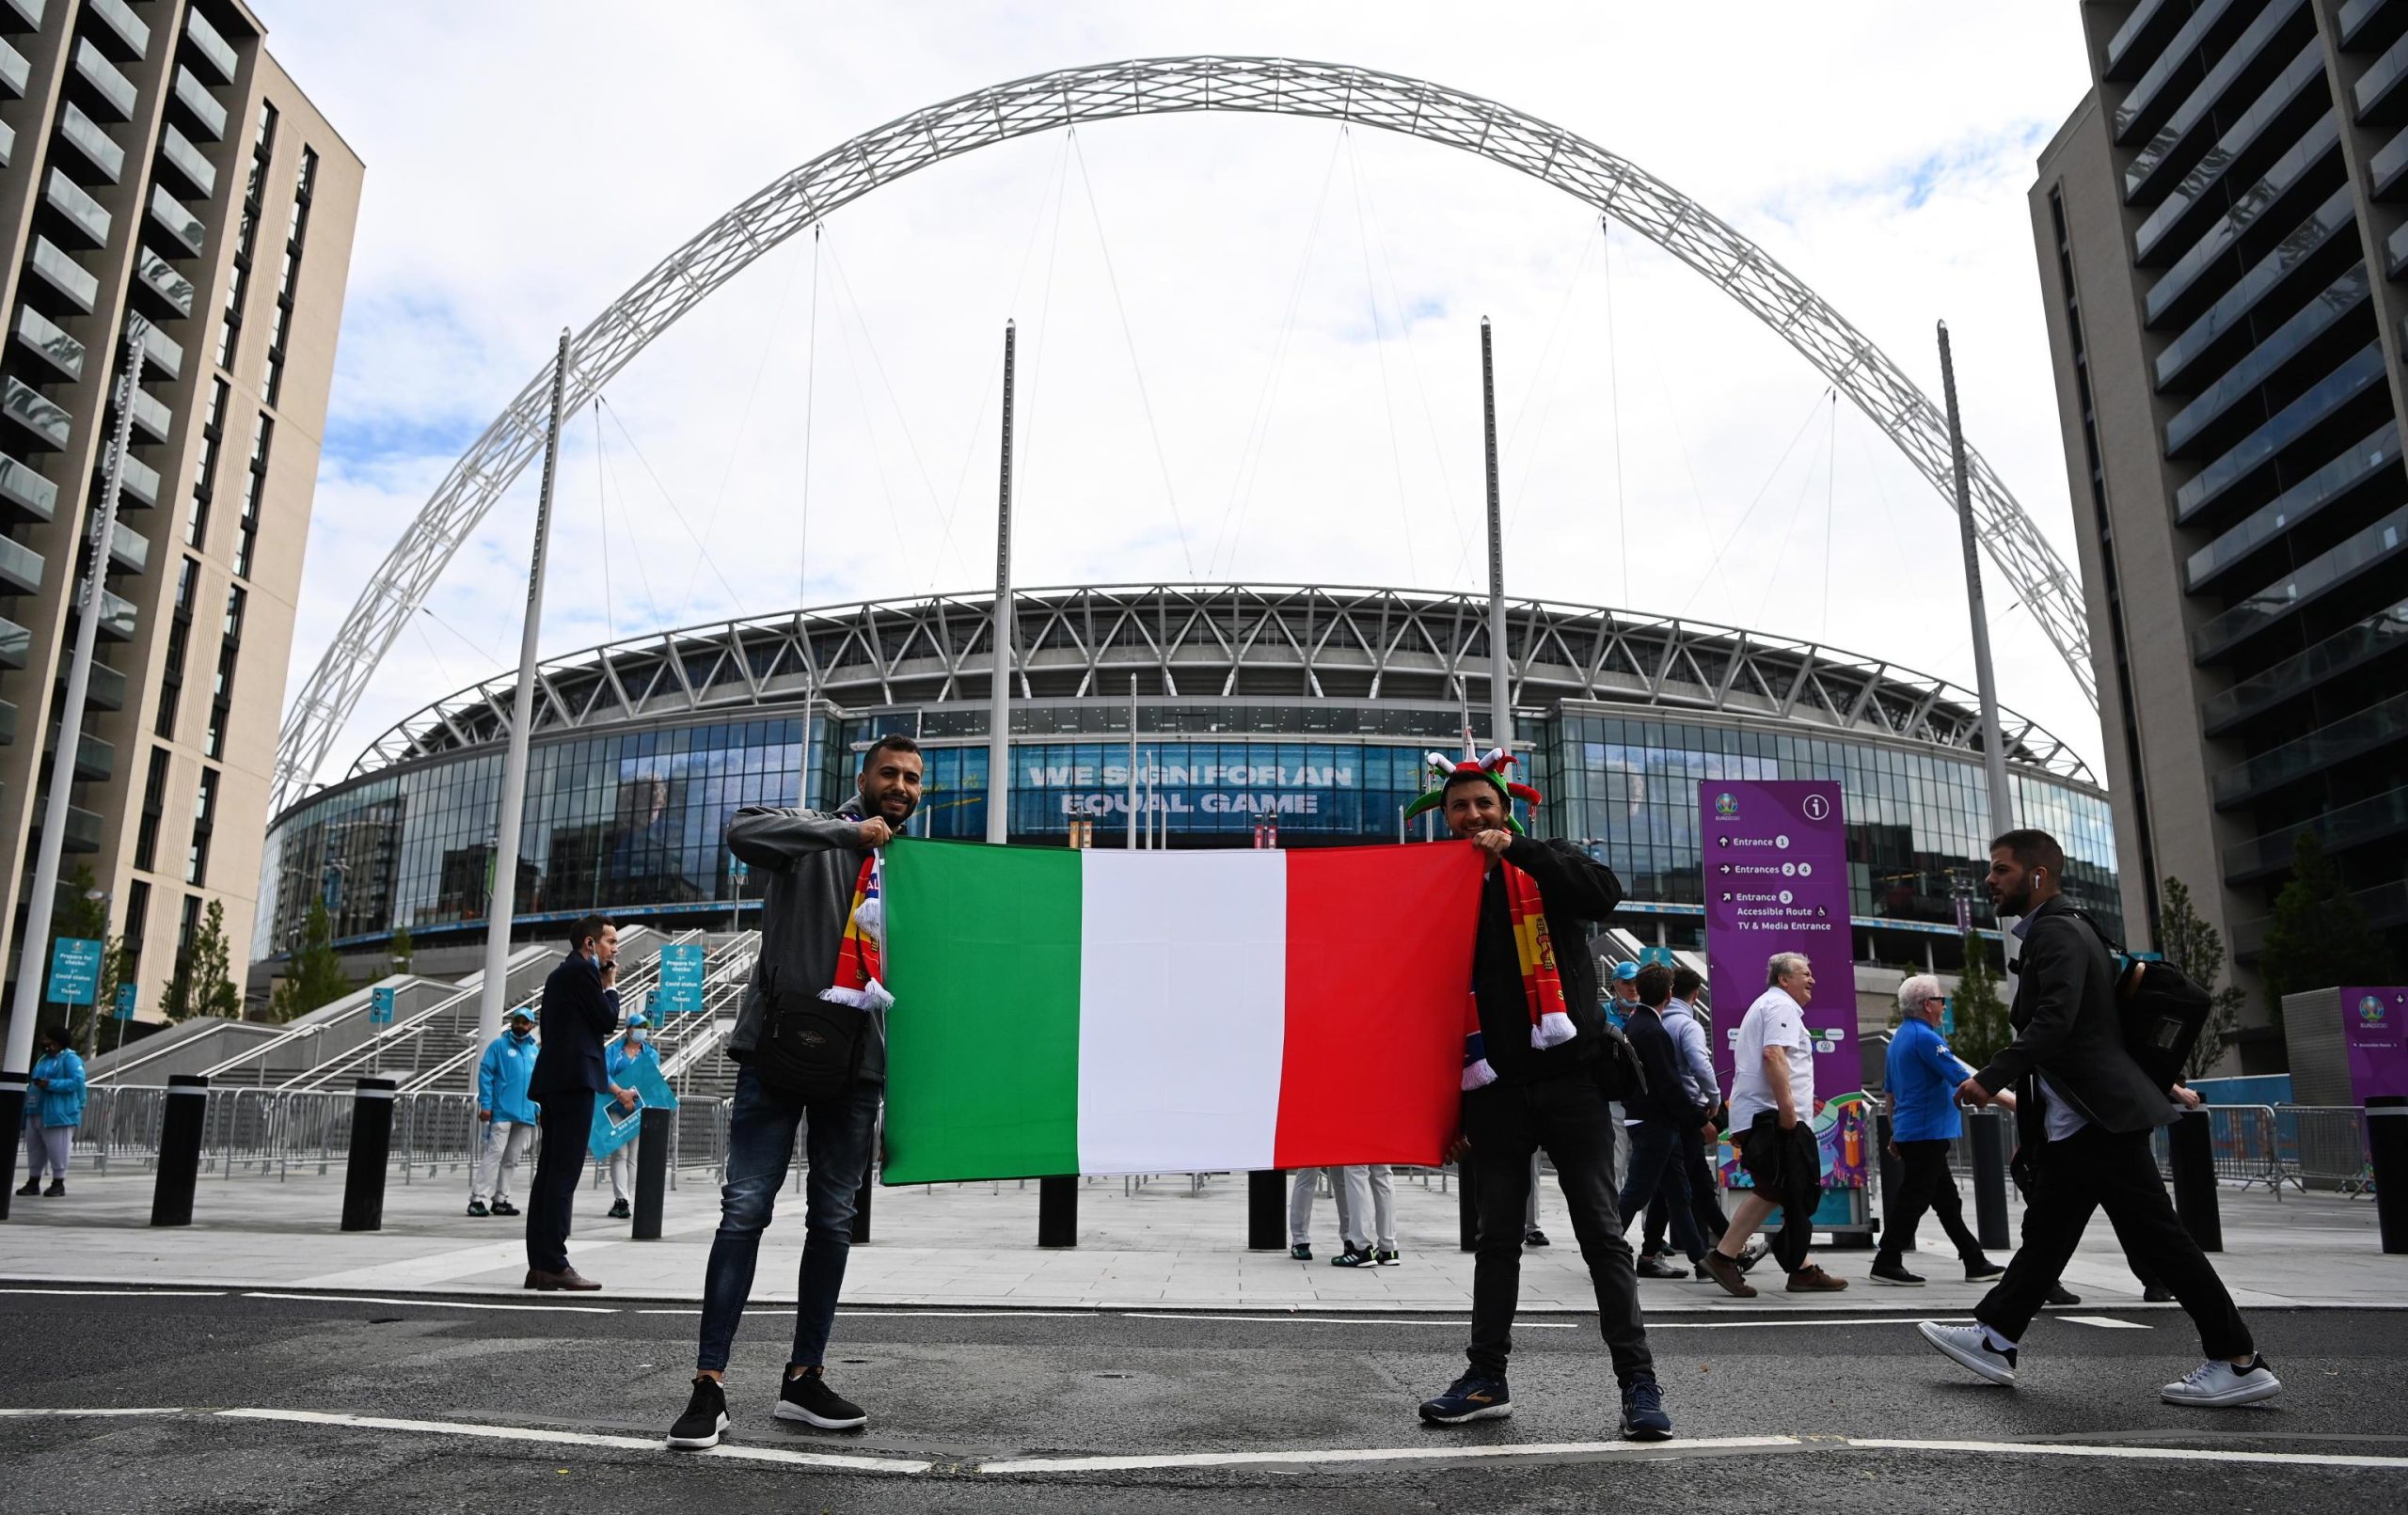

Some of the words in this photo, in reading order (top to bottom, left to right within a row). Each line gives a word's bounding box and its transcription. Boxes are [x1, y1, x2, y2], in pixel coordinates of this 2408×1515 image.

[1029, 766, 1093, 786] WE
[1204, 765, 1288, 785] FOR
[1292, 766, 1352, 786] AN
[1061, 794, 1195, 816] EQUAL
[1200, 795, 1318, 814] GAME
[1733, 838, 1773, 846] Entrance
[1735, 865, 1780, 874] Entrances
[1736, 893, 1777, 902] Entrance
[1737, 907, 1783, 916] Accessible
[1786, 907, 1813, 916] Route
[1737, 922, 1750, 930] TV
[1762, 922, 1788, 930] Media
[1791, 923, 1831, 931] Entrance
